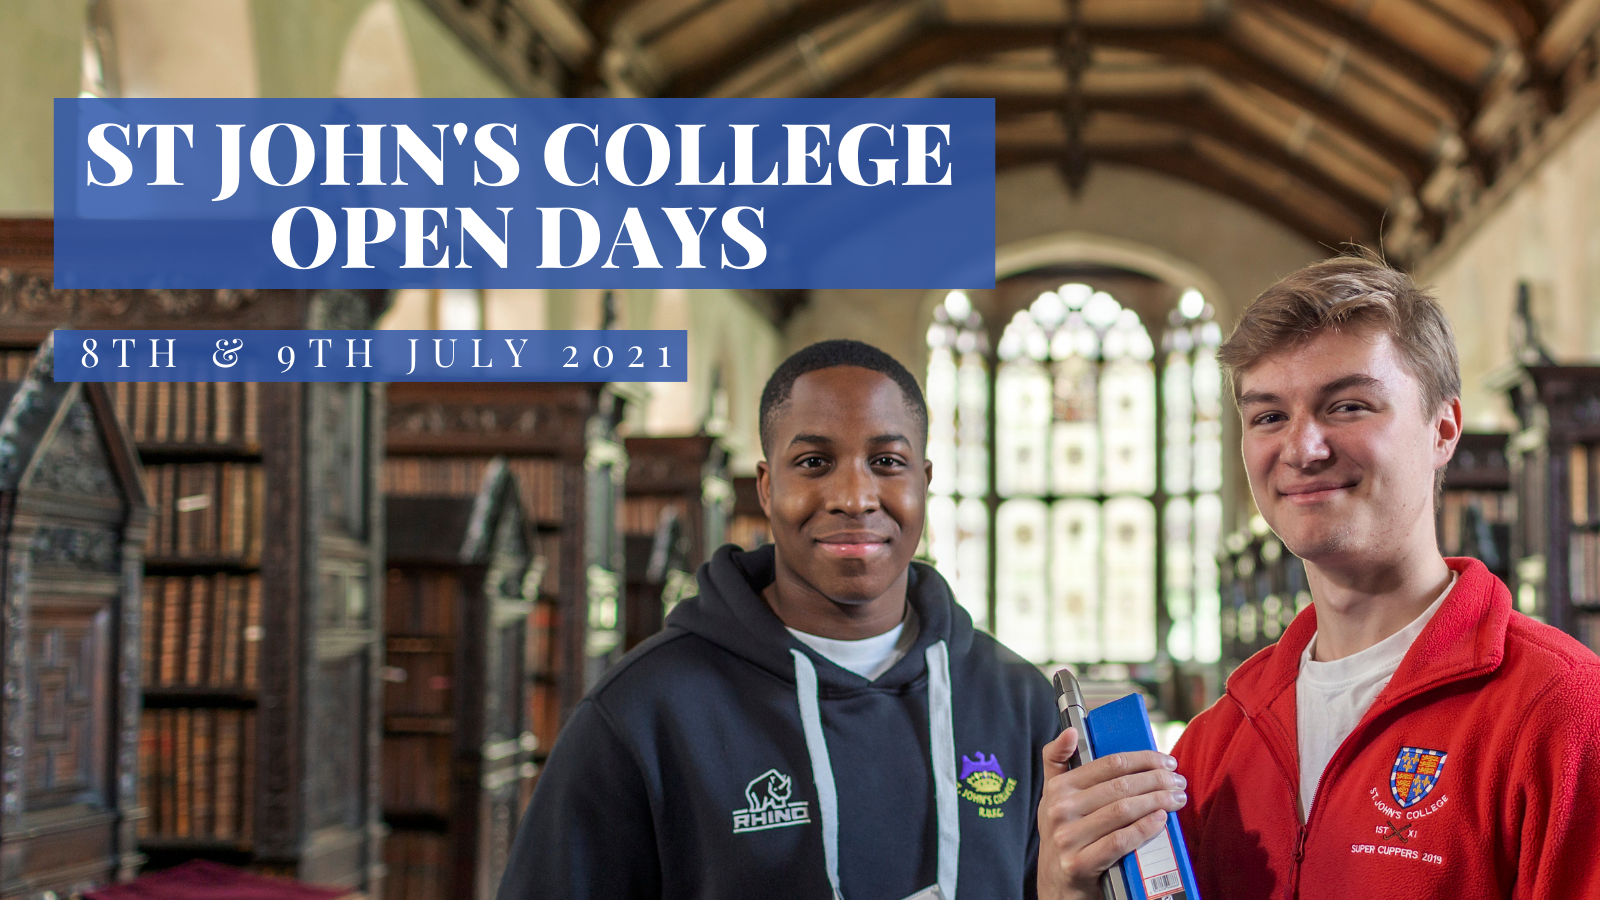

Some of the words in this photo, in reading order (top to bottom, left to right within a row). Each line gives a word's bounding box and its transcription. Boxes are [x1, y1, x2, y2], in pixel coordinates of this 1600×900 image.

[961, 788, 993, 806] JOHN'S
[993, 777, 1018, 805] COLLEGE
[733, 806, 809, 829] RHINO
[1374, 800, 1402, 819] JOHN'S
[1406, 794, 1449, 820] COLLEGE
[1407, 829, 1418, 838] XI
[1351, 844, 1375, 854] SUPER
[1377, 845, 1419, 860] CUPPERS
[1421, 852, 1443, 865] 2019
